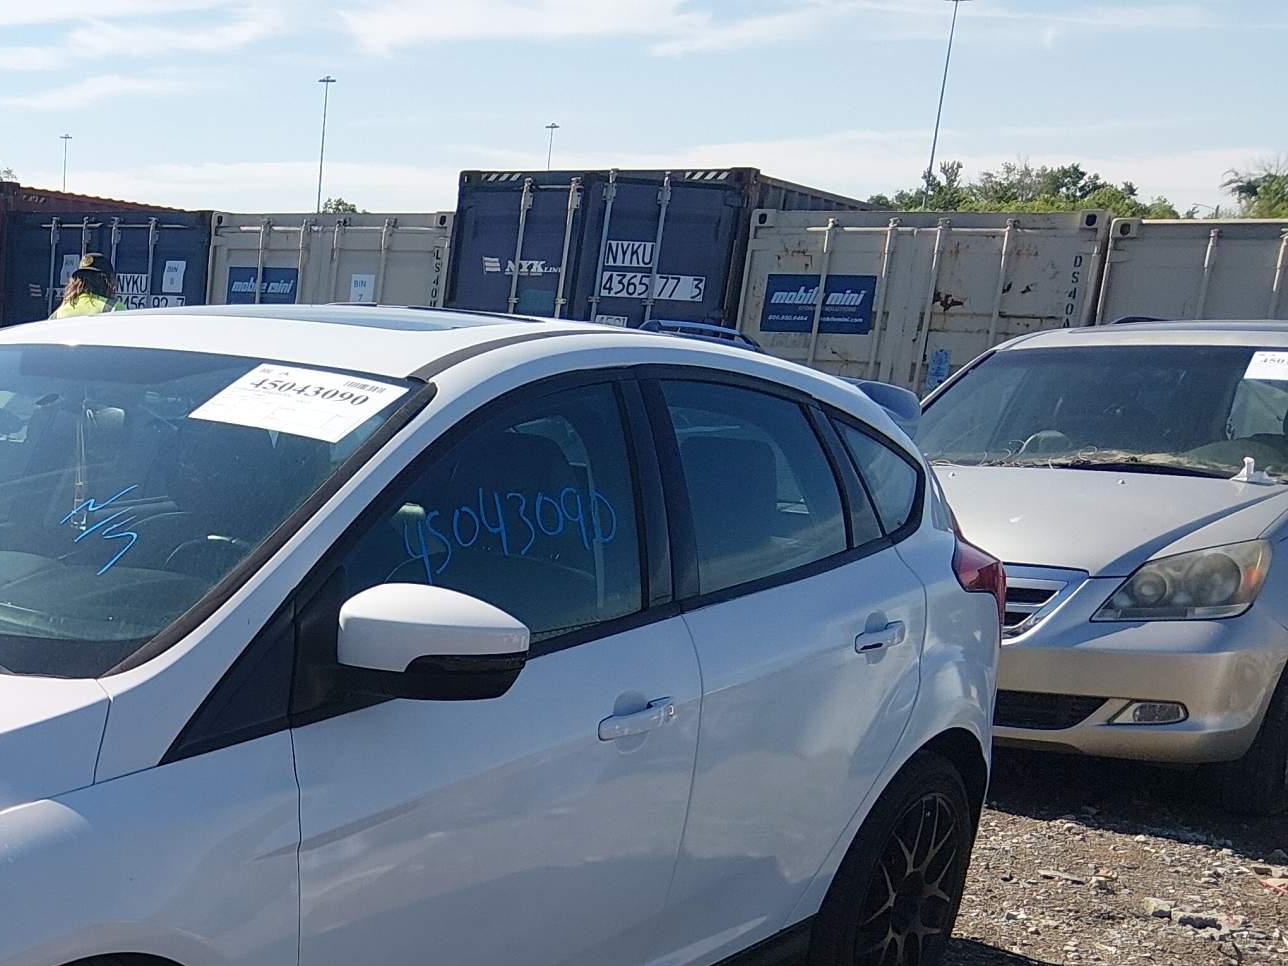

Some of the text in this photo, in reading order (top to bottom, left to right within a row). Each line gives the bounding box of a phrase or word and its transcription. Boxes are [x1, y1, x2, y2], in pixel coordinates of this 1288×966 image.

[607, 242, 655, 266] NYKU
[117, 274, 148, 293] NYKU
[268, 279, 294, 294] mini
[353, 280, 368, 289] BIN
[690, 278, 705, 300] 3
[770, 286, 867, 306] mobil mini
[249, 377, 371, 407] 45043090
[403, 487, 617, 586] 45043090
